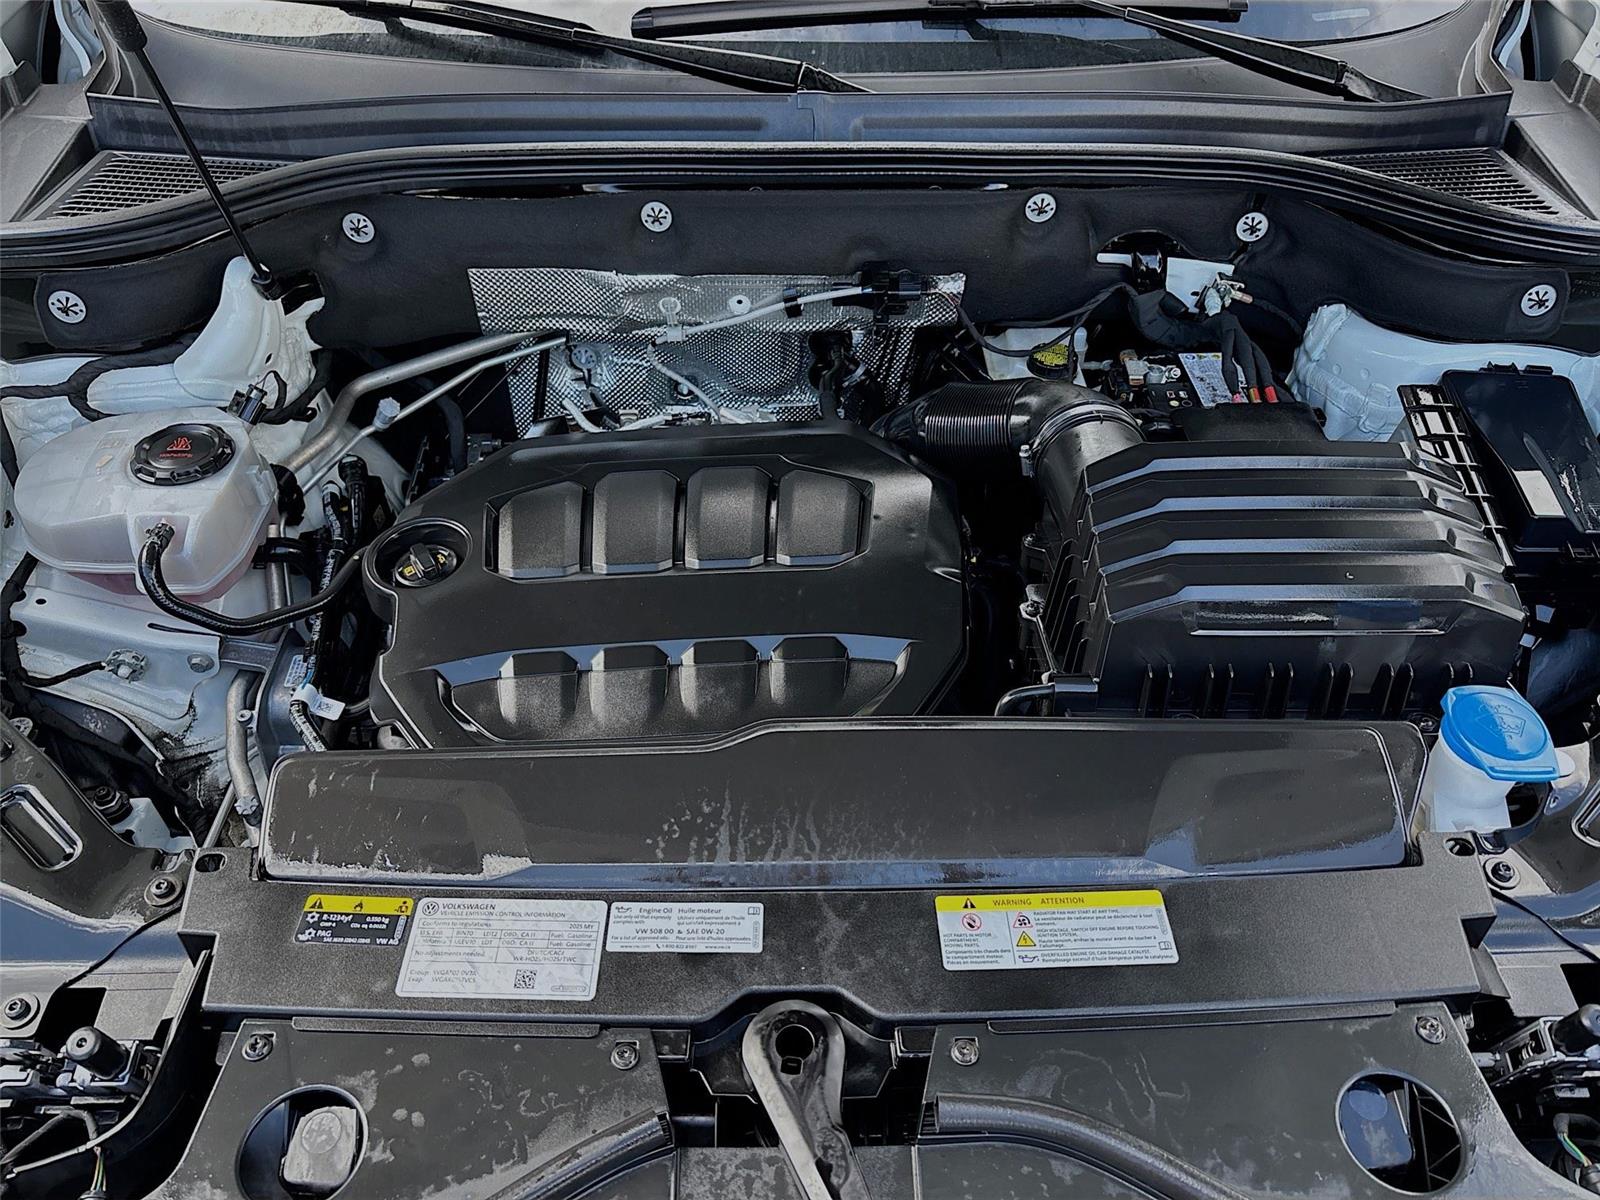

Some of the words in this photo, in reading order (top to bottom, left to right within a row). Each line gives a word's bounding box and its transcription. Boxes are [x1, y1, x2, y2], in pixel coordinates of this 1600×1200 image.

[993, 898, 1032, 906] WARNING
[1040, 897, 1085, 905] ATTENTION
[322, 914, 353, 923] R-1234yf
